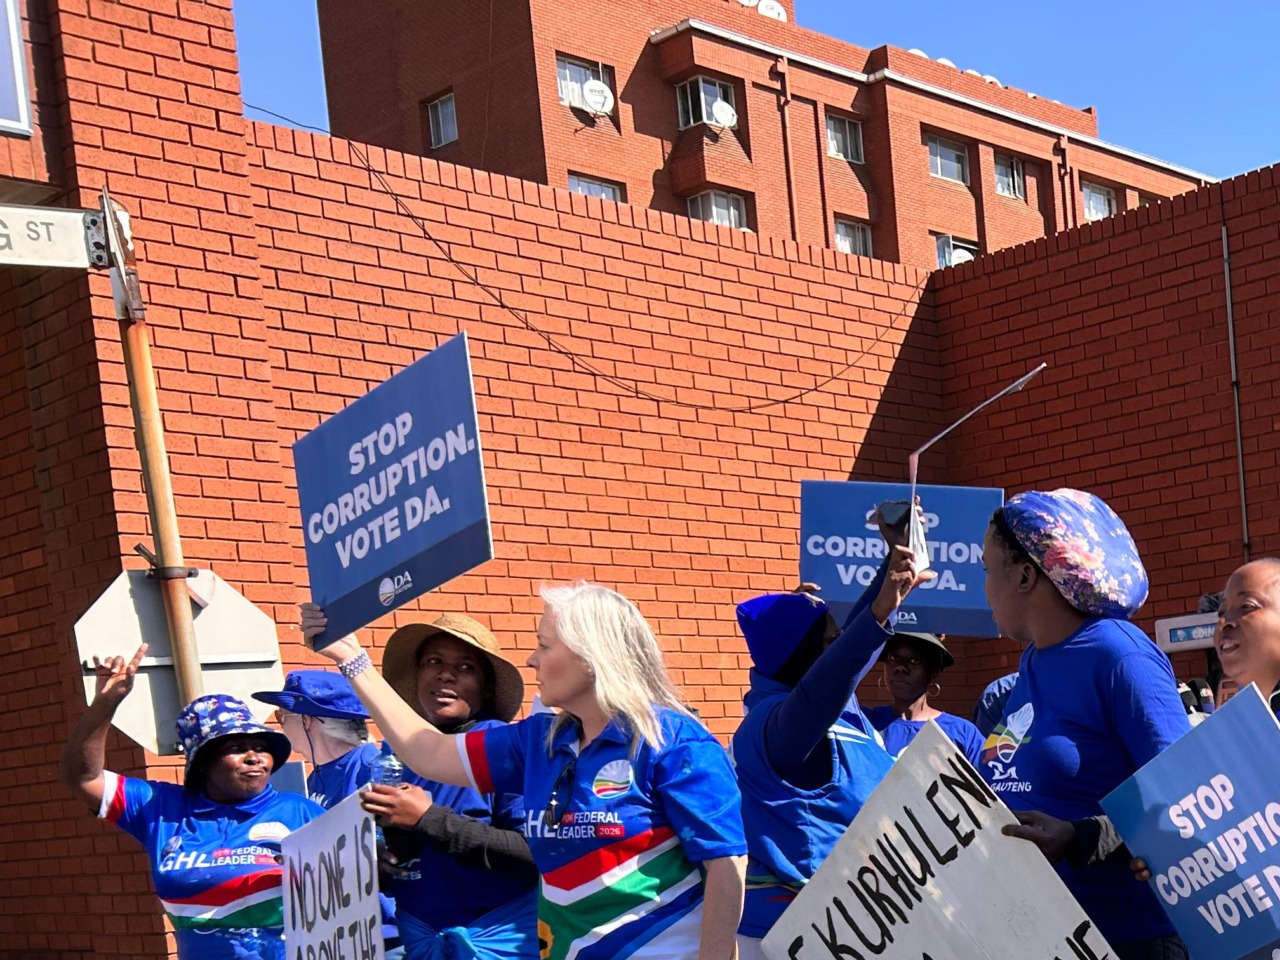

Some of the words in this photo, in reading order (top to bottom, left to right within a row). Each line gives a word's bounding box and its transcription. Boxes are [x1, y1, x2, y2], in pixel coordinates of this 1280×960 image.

[26, 220, 55, 242] ST
[349, 412, 413, 475] STOP
[308, 423, 475, 544] CORRUPTION.
[335, 506, 401, 569] VOTE
[404, 485, 450, 531] DA.
[865, 509, 940, 534] SP
[806, 534, 985, 564] CORRTION
[394, 571, 412, 589] DA
[898, 611, 917, 621] DA
[991, 782, 1032, 793] GAUTENG
[573, 811, 623, 824] FEDERAL
[1168, 773, 1235, 839] STOP
[557, 824, 596, 840] LEADER
[599, 828, 622, 836] 2026
[160, 850, 211, 872] GHL
[231, 845, 276, 858] FEDERAL
[211, 854, 256, 867] LEADER
[289, 851, 316, 934] NO
[318, 833, 351, 922] ONE
[354, 816, 374, 903] IS
[1197, 874, 1274, 935] VOTE
